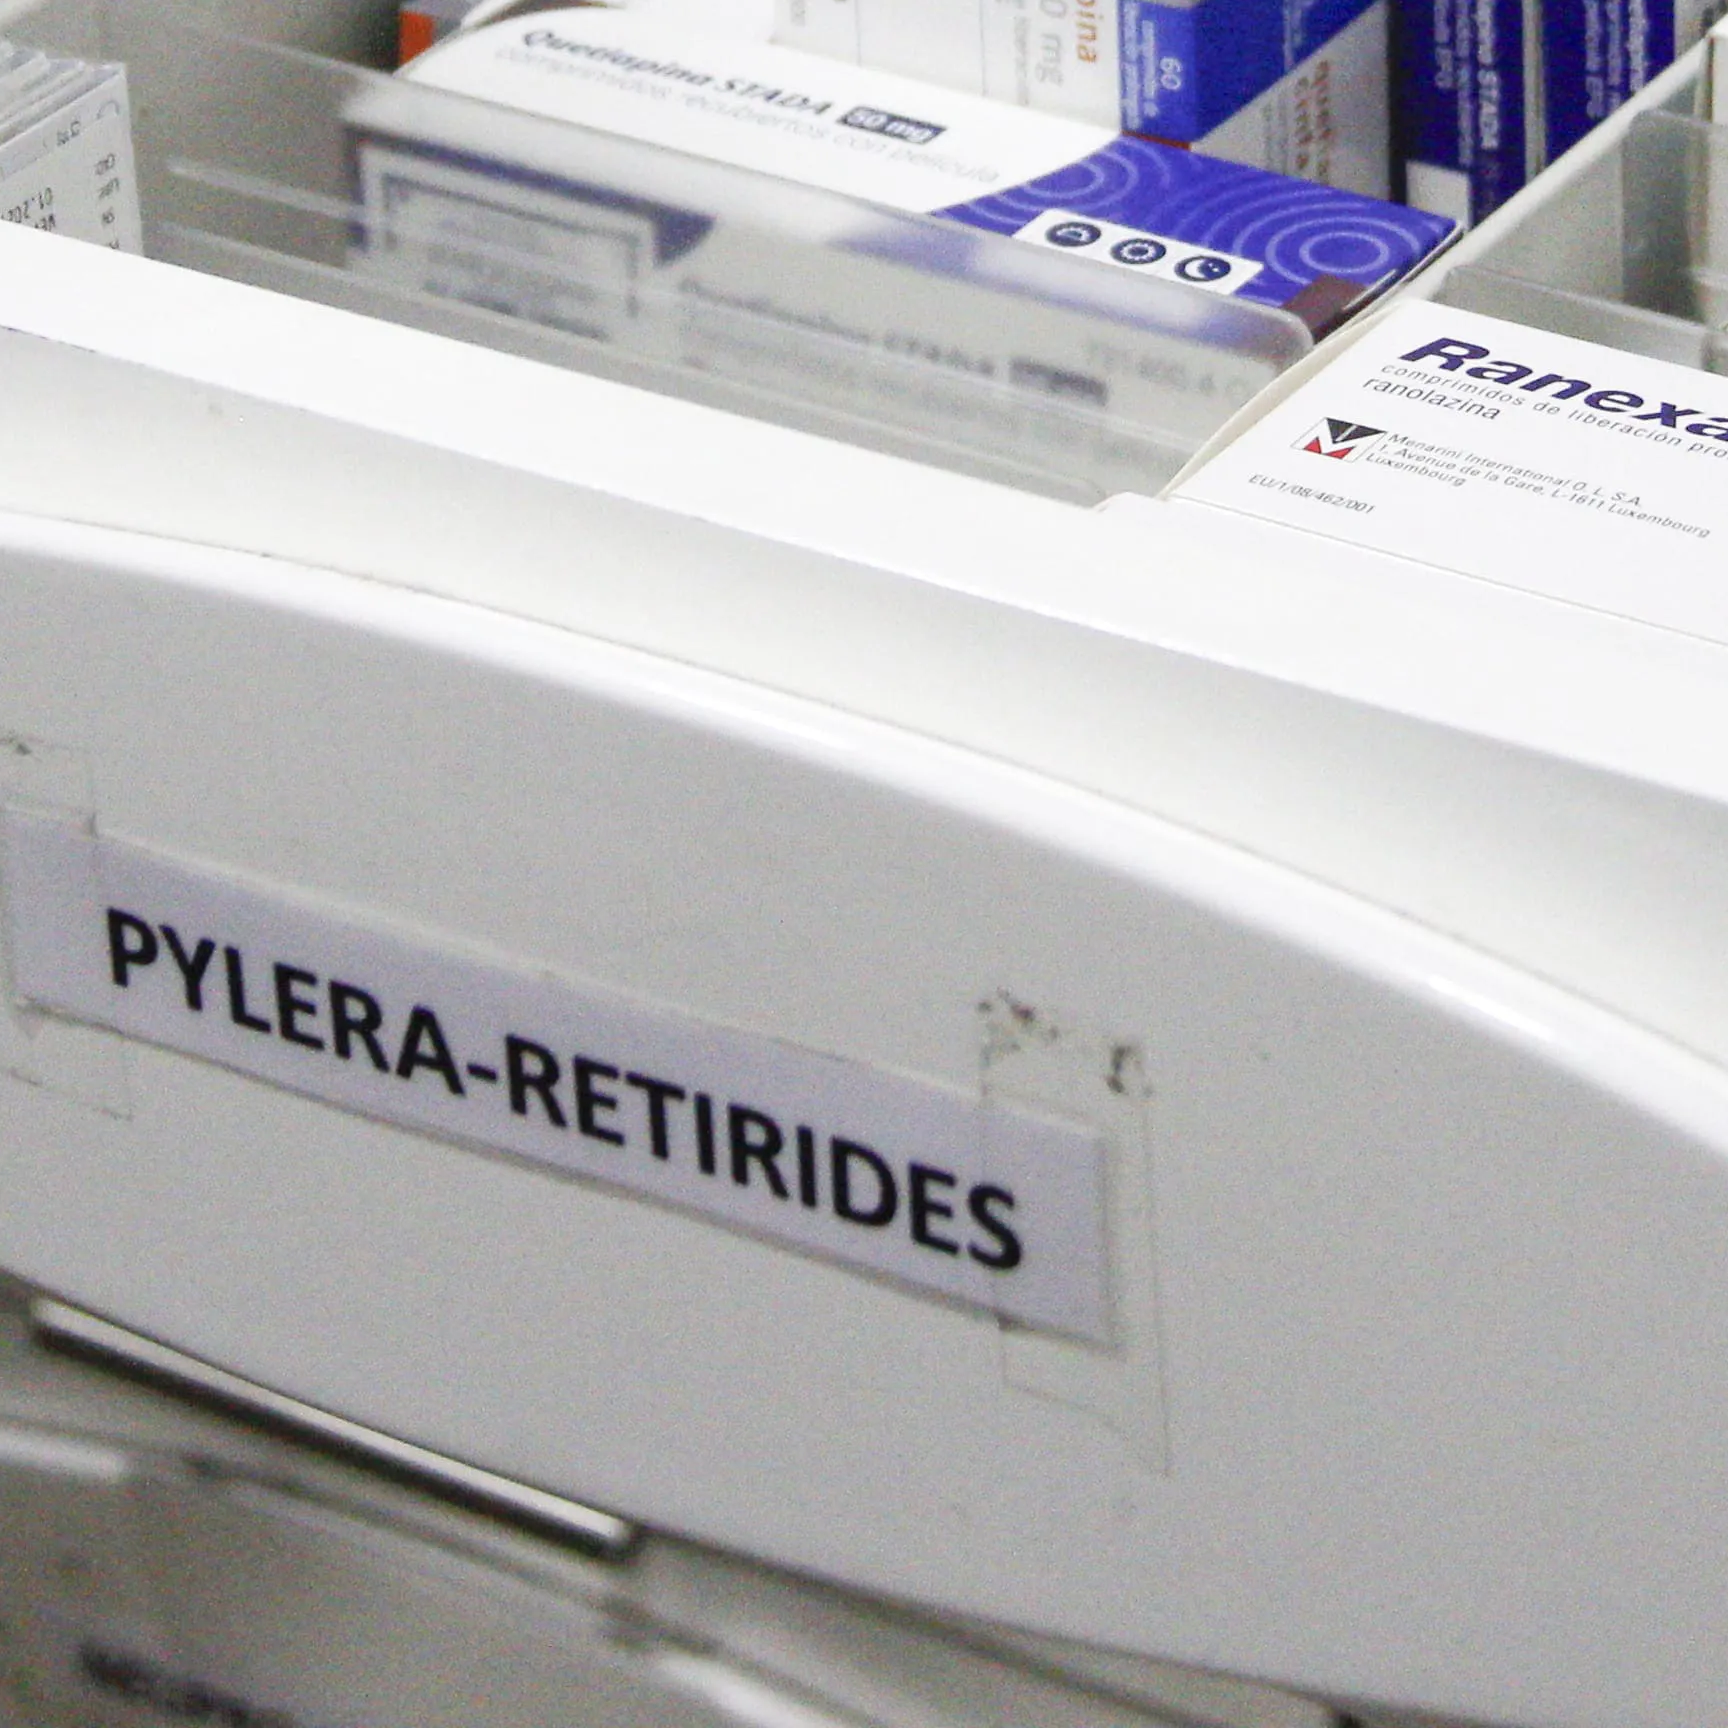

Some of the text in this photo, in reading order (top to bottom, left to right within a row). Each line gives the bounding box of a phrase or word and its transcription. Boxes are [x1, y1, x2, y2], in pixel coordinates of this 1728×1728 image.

[523, 29, 714, 87] Quetiapina
[715, 77, 835, 116] STADA
[1158, 55, 1184, 92] 60
[1362, 375, 1501, 421] ranolazina
[1380, 363, 1526, 407] comprimidos
[1533, 398, 1562, 416] de
[1566, 408, 1682, 447] liberación
[1365, 452, 1467, 487] Luxembourg
[1388, 432, 1462, 461] Menarini
[1463, 451, 1571, 489] International
[1248, 472, 1376, 515] EU/1/08/462/001
[1395, 446, 1457, 473] Avenue
[1458, 461, 1480, 476] de
[1482, 467, 1500, 482] la
[1551, 488, 1605, 510] L-1611
[1607, 502, 1711, 540] Luxembourg
[105, 905, 1024, 1271] PYLERA-RETIRIDES
